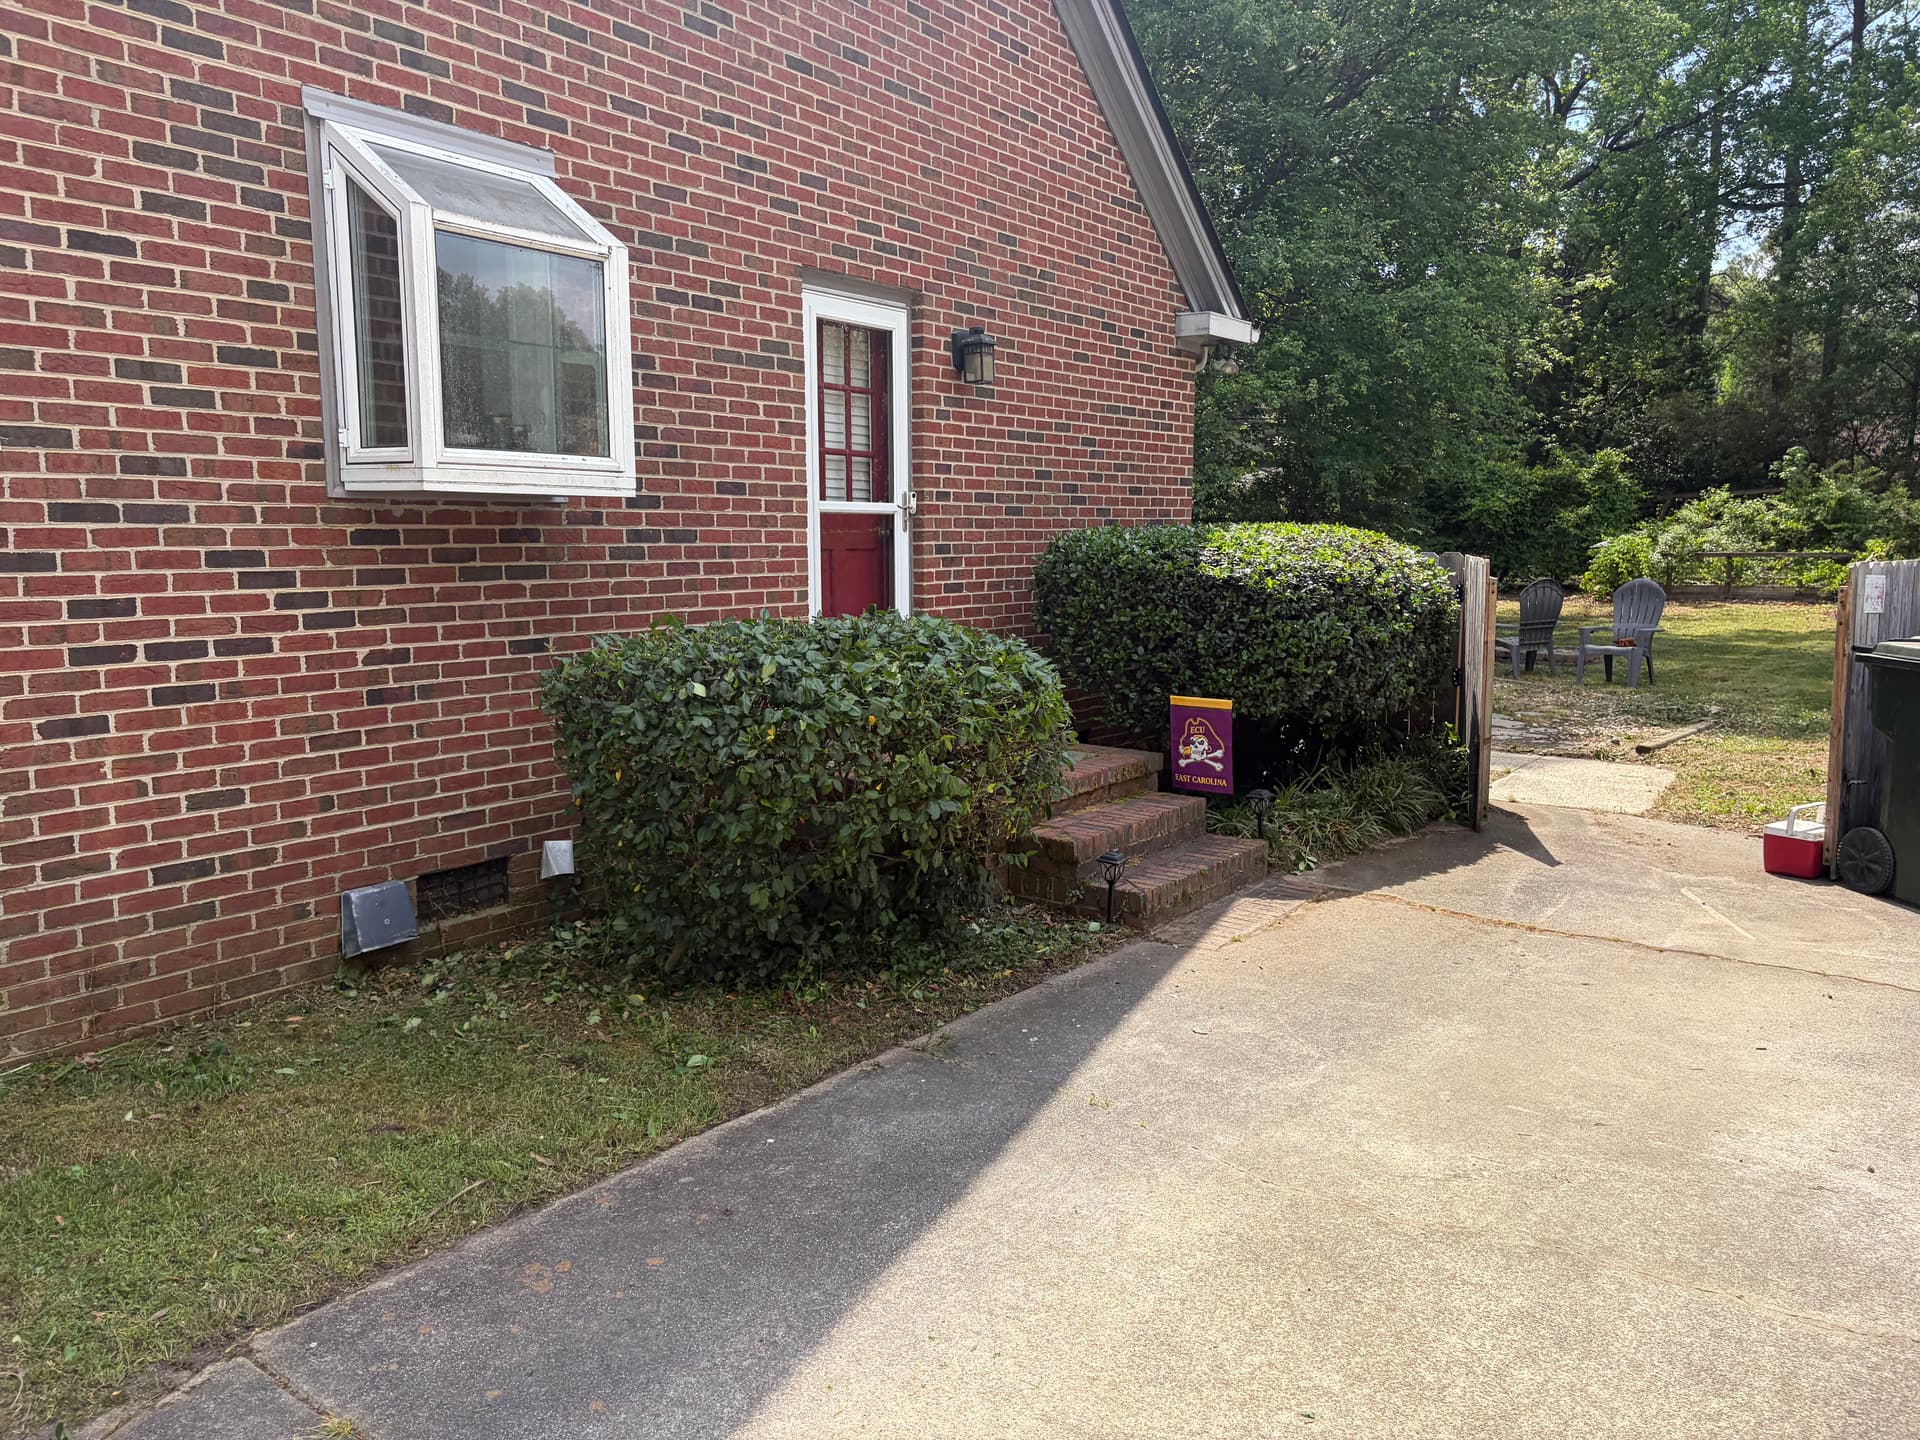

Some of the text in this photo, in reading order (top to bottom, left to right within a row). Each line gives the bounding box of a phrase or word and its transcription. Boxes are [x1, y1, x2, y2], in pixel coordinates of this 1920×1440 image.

[1190, 726, 1205, 734] ECU
[1175, 773, 1228, 787] EAST CAROLINA
